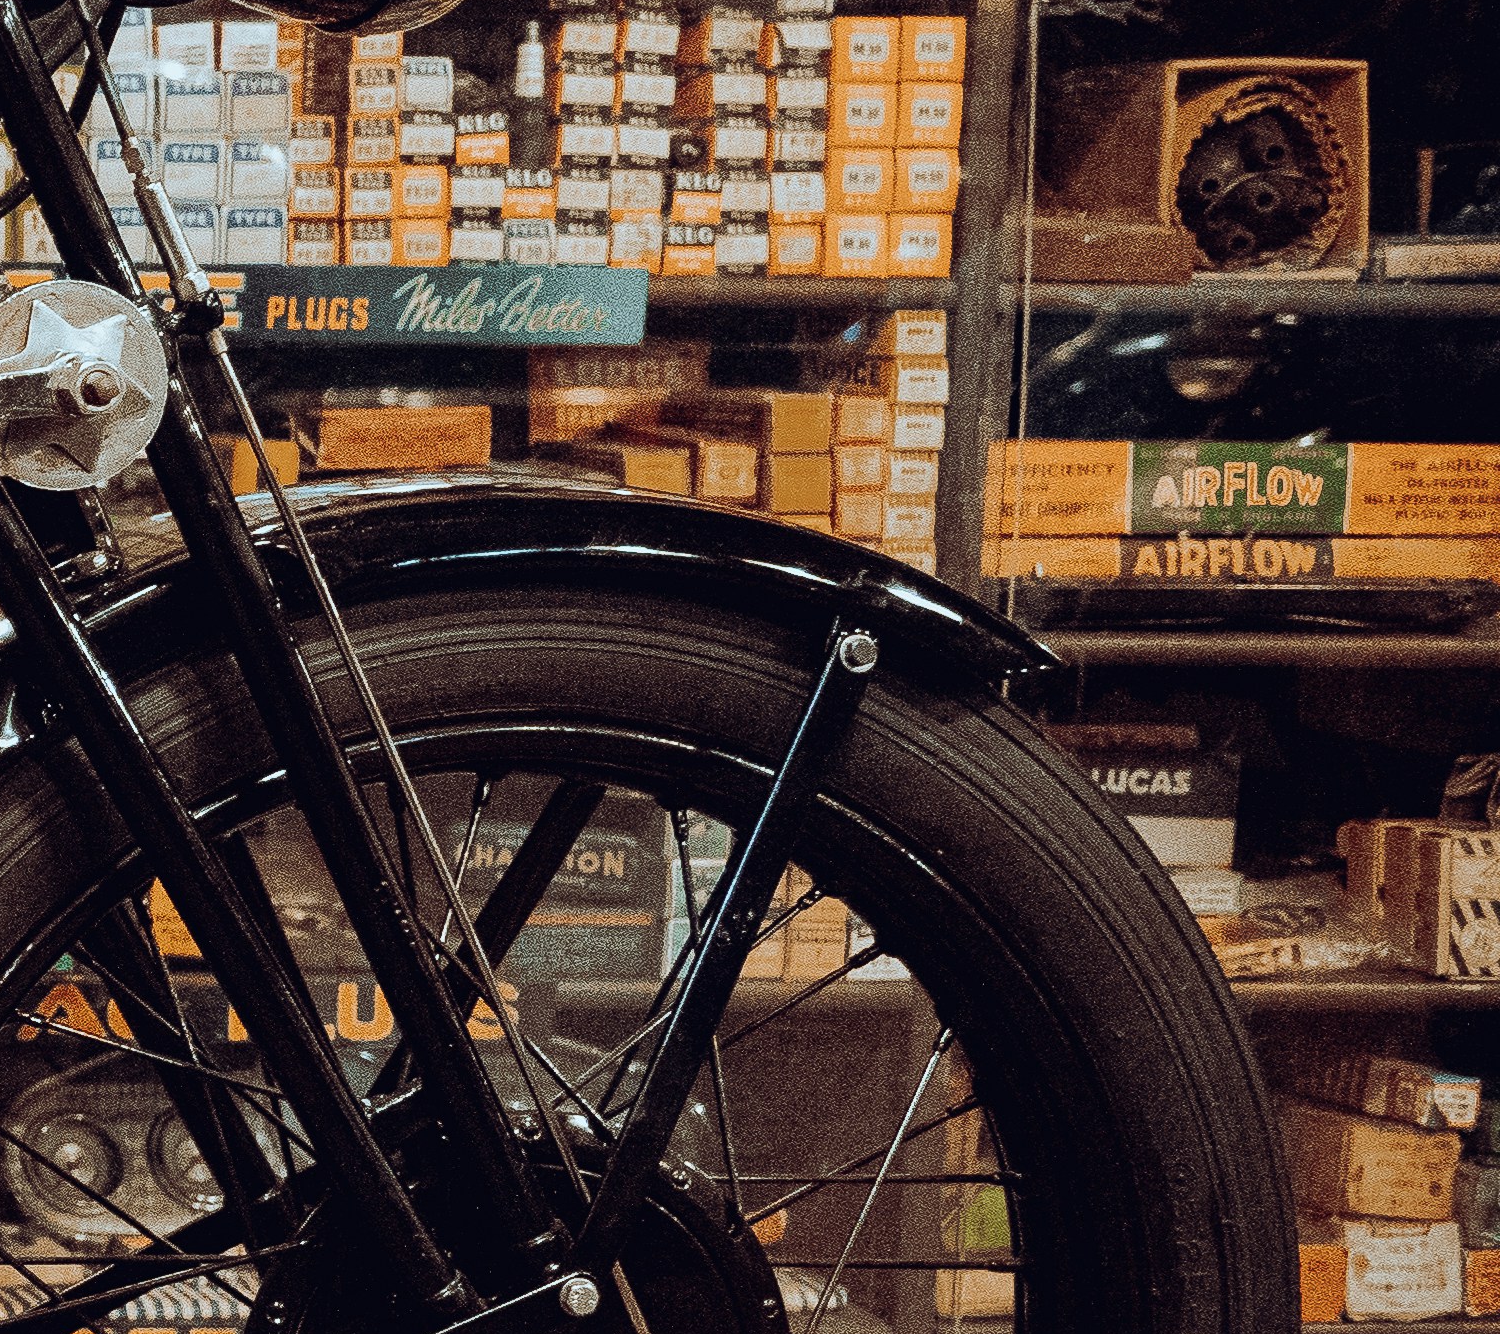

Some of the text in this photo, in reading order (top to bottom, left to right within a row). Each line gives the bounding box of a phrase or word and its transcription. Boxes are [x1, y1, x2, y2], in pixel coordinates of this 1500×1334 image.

[265, 295, 370, 332] PLUGS
[392, 272, 496, 334] Miles
[1151, 460, 1324, 508] AIRFLOW
[1133, 537, 1317, 578] AIRFLOW
